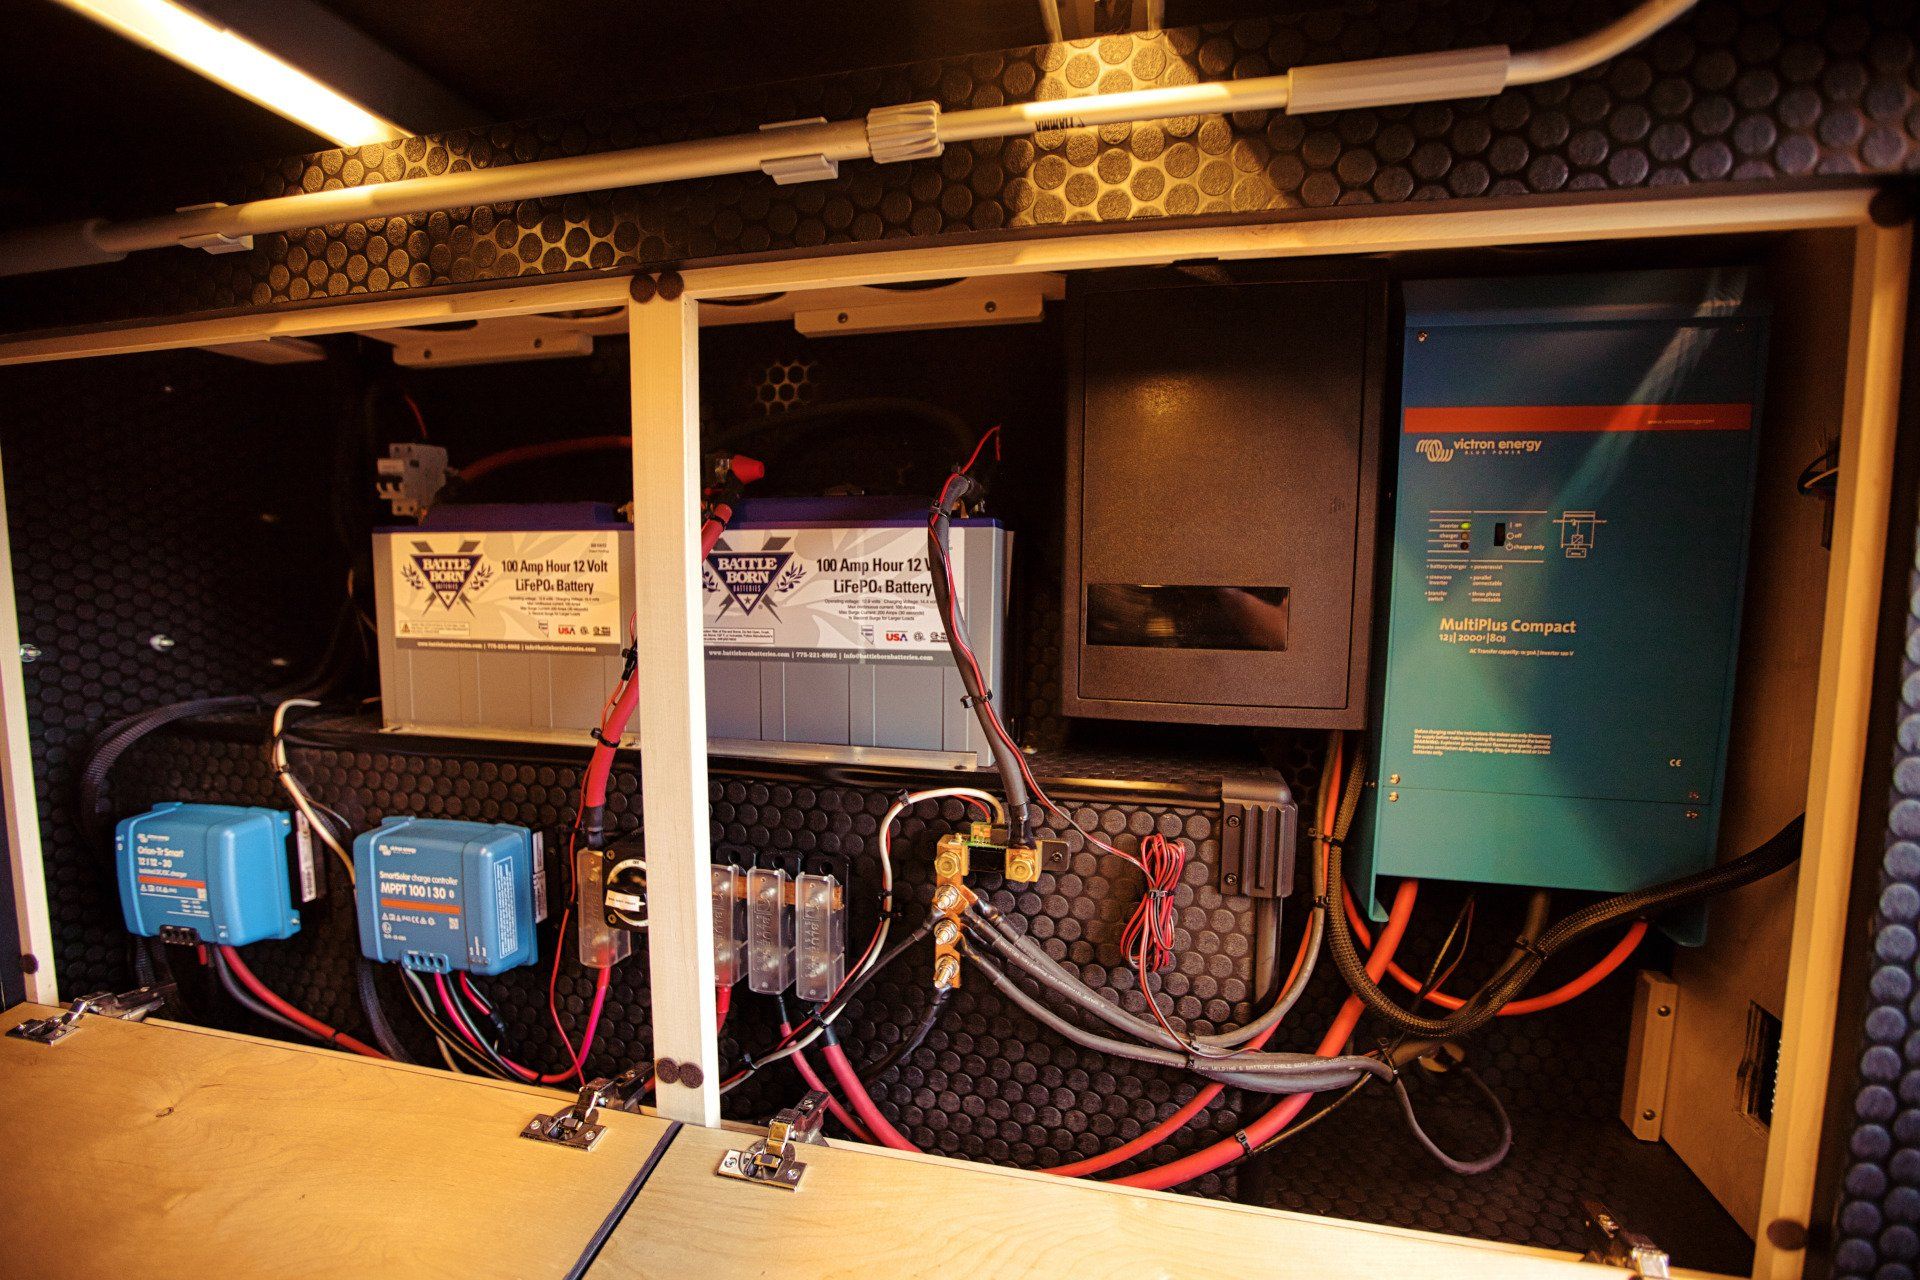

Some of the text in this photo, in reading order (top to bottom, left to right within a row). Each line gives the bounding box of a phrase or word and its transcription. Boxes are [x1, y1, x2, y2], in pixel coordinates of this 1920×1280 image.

[1453, 438, 1542, 452] victron energy
[422, 558, 472, 571] BATTLE
[501, 560, 608, 575] 100 Amp Hour 12 Volt
[717, 558, 778, 571] BATTLE
[816, 558, 837, 572] 100
[840, 558, 869, 576] Amp
[873, 558, 904, 572] Hour
[907, 558, 921, 572] 12
[430, 571, 465, 583] BORN
[726, 571, 770, 584] BORN
[556, 579, 594, 595] Battery
[885, 579, 932, 597] Battery
[558, 627, 576, 636] USA
[1440, 617, 1577, 636] MultiPlus Compact
[885, 633, 908, 642] USA
[379, 870, 459, 886] SmartSolar charge controller
[380, 881, 407, 896] MPPT
[408, 884, 426, 898] 100
[432, 887, 447, 900] 30
[811, 922, 820, 950] BLUE
